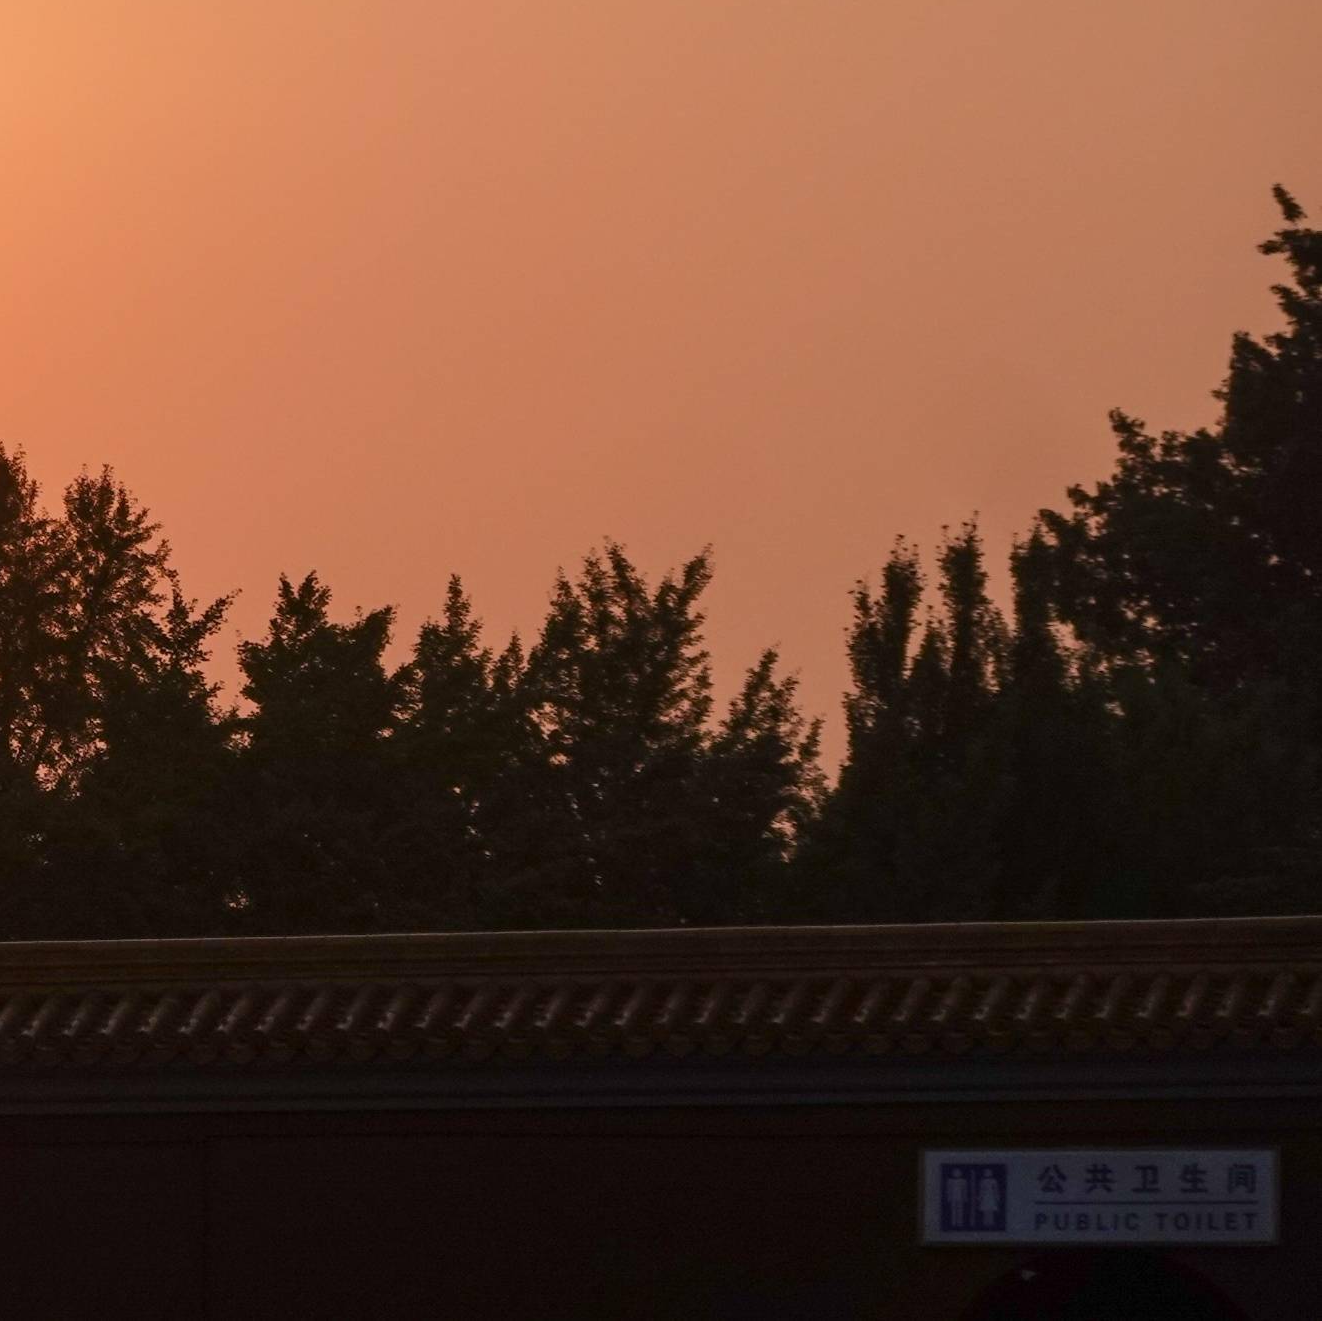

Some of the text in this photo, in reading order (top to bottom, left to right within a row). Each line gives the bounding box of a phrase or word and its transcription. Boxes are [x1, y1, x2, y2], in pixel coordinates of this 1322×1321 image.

[1037, 1163, 1257, 1194] 公共卫生间
[1034, 1212, 1258, 1231] PUBLIC TOILET
